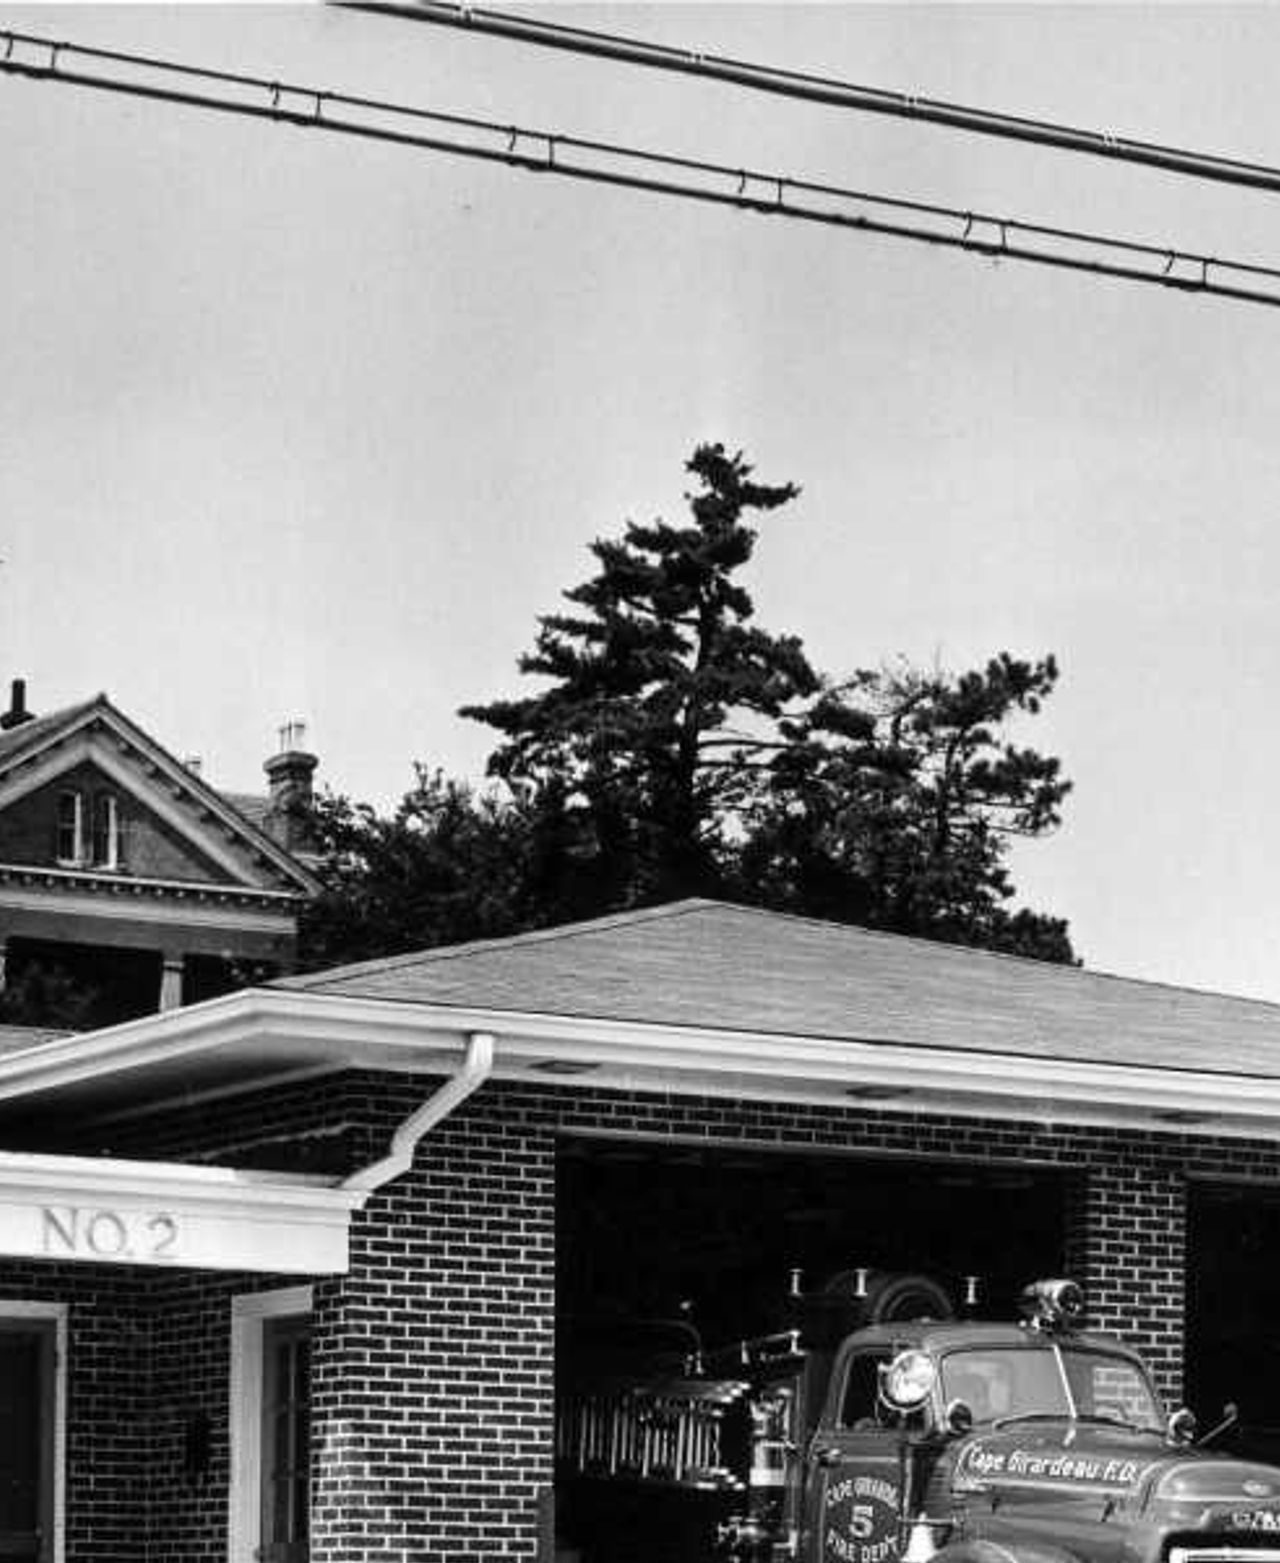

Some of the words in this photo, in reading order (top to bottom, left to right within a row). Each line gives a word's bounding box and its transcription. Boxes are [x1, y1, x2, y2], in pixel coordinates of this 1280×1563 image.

[969, 1446, 1006, 1474] Cape
[1007, 1450, 1100, 1480] Girardeau
[827, 1479, 852, 1508] CAPE
[848, 1504, 874, 1539] 5
[825, 1528, 855, 1562] FIRE
